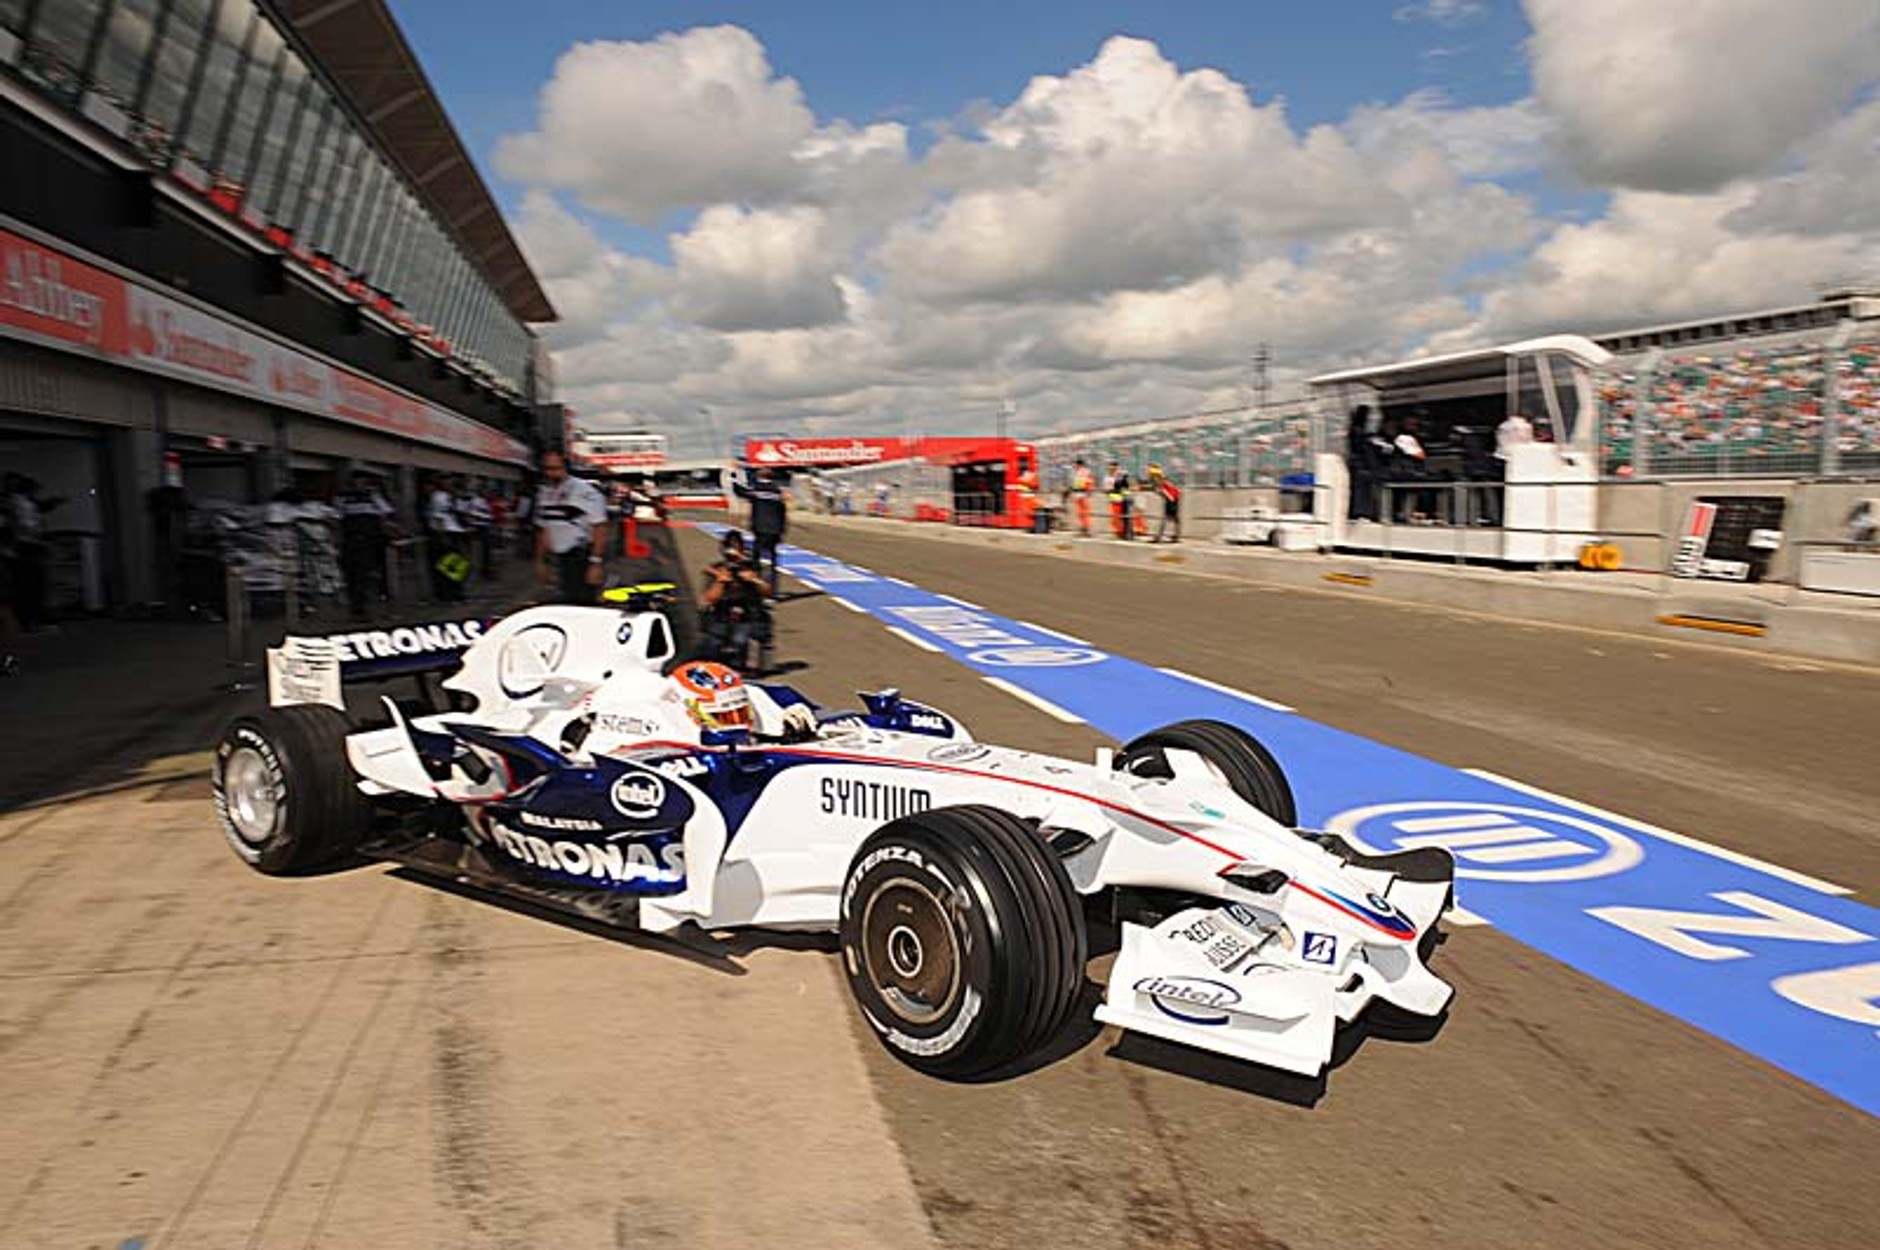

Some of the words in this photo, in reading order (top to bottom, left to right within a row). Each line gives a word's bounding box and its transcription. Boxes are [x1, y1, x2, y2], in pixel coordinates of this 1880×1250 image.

[328, 619, 482, 661] ETRONAS
[821, 777, 930, 821] SYNTIUM
[1147, 977, 1224, 1008] intel
